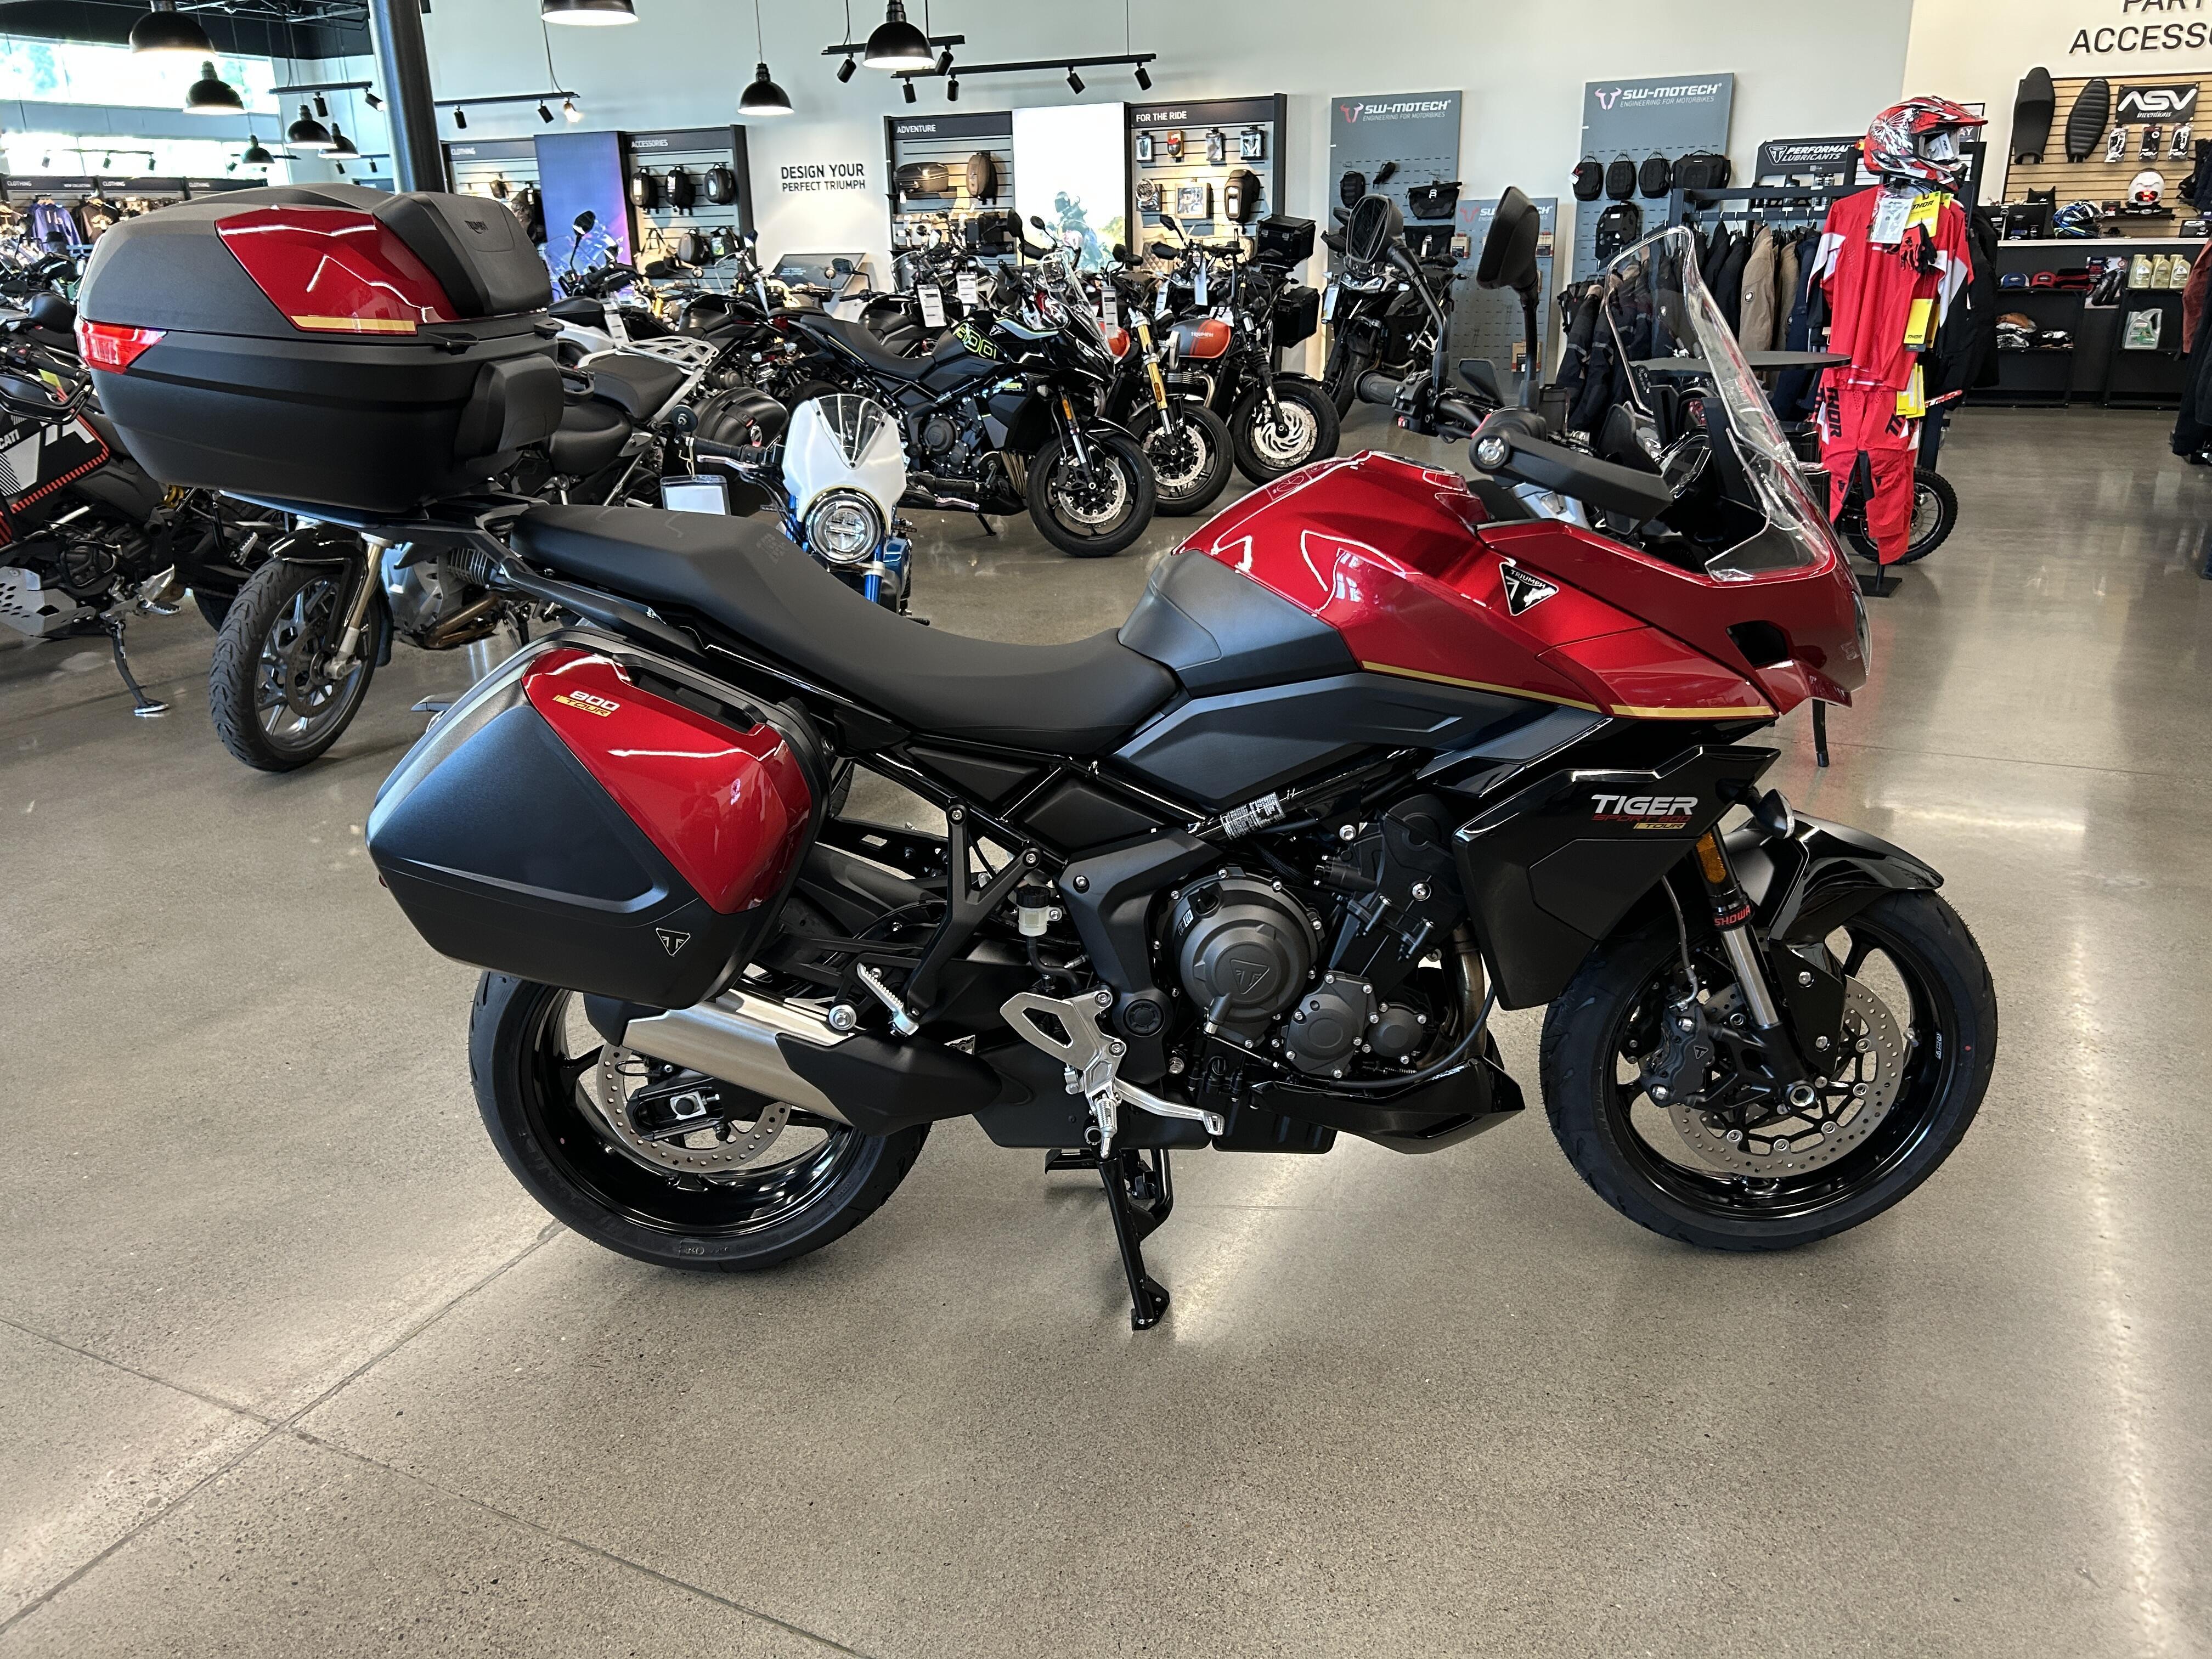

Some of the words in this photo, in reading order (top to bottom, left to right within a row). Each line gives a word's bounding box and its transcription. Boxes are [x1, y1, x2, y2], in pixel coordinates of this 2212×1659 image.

[2069, 22, 2212, 54] ACCESS
[1620, 98, 1661, 108] ENGINEERING
[1676, 95, 1714, 104] MOTORBIKES
[2118, 88, 2197, 111] ASV
[1136, 114, 1151, 122] FOR
[1153, 112, 1167, 121] THE
[1169, 111, 1187, 120] RIDE
[1362, 114, 1398, 122] ENGINEERING
[896, 124, 936, 134] ADVENTURE
[631, 139, 668, 148] ACCESSORIES
[1781, 153, 1841, 162] LUBRICANTS
[781, 165, 825, 179] DESIGN
[828, 163, 865, 177] YOUR
[782, 182, 821, 192] PERFECT
[825, 179, 866, 190] TRIUMPH
[1912, 200, 1934, 210] THOR
[1510, 569, 1546, 589] TRIUMPH
[566, 698, 608, 715] TOUR
[569, 691, 620, 712] 800
[1591, 794, 1698, 815] TIGER
[1714, 904, 1751, 926] SHOWA
